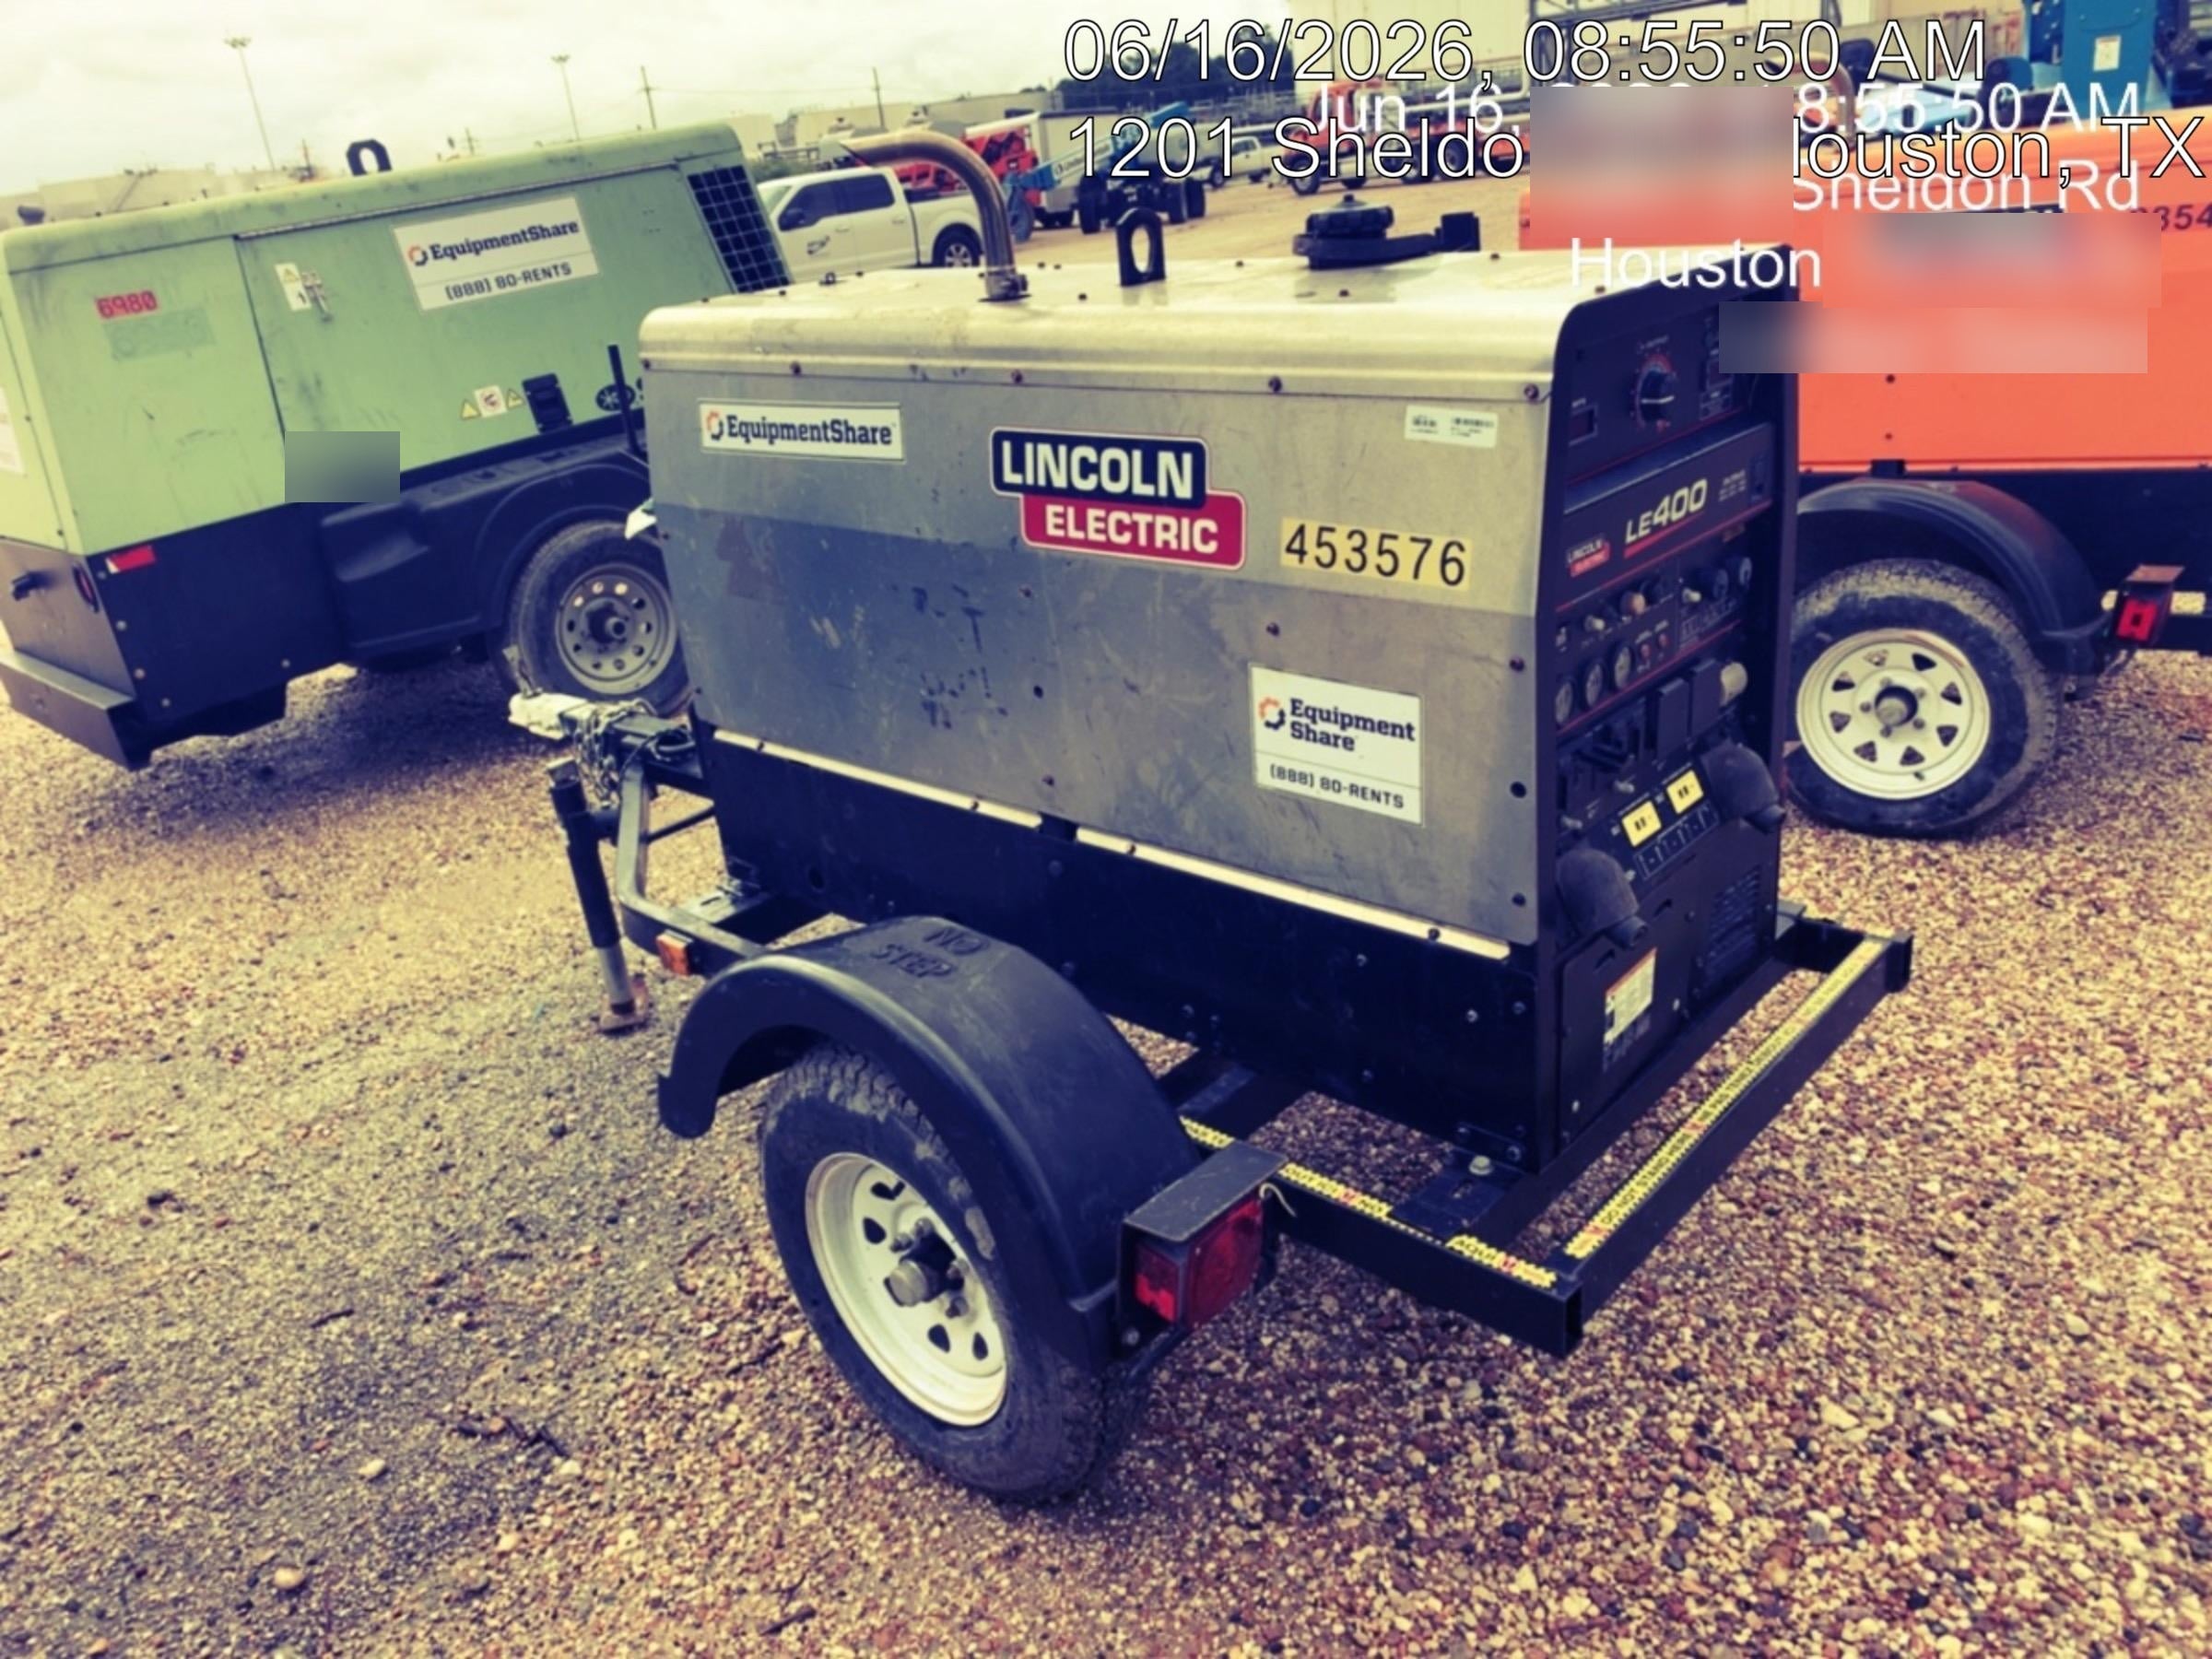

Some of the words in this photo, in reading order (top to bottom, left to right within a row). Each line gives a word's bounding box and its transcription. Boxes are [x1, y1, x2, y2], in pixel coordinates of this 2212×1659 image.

[429, 220, 580, 262] EquipmentShare
[444, 277, 492, 300] (888)
[726, 415, 892, 445] EquipmentShare
[1002, 440, 1194, 500] LINCOLN
[1045, 503, 1218, 554] ELECTRIC
[1285, 524, 1465, 586] 453576
[1290, 698, 1416, 741] Equipment
[1290, 721, 1355, 751] Share
[1270, 764, 1315, 788] (888)
